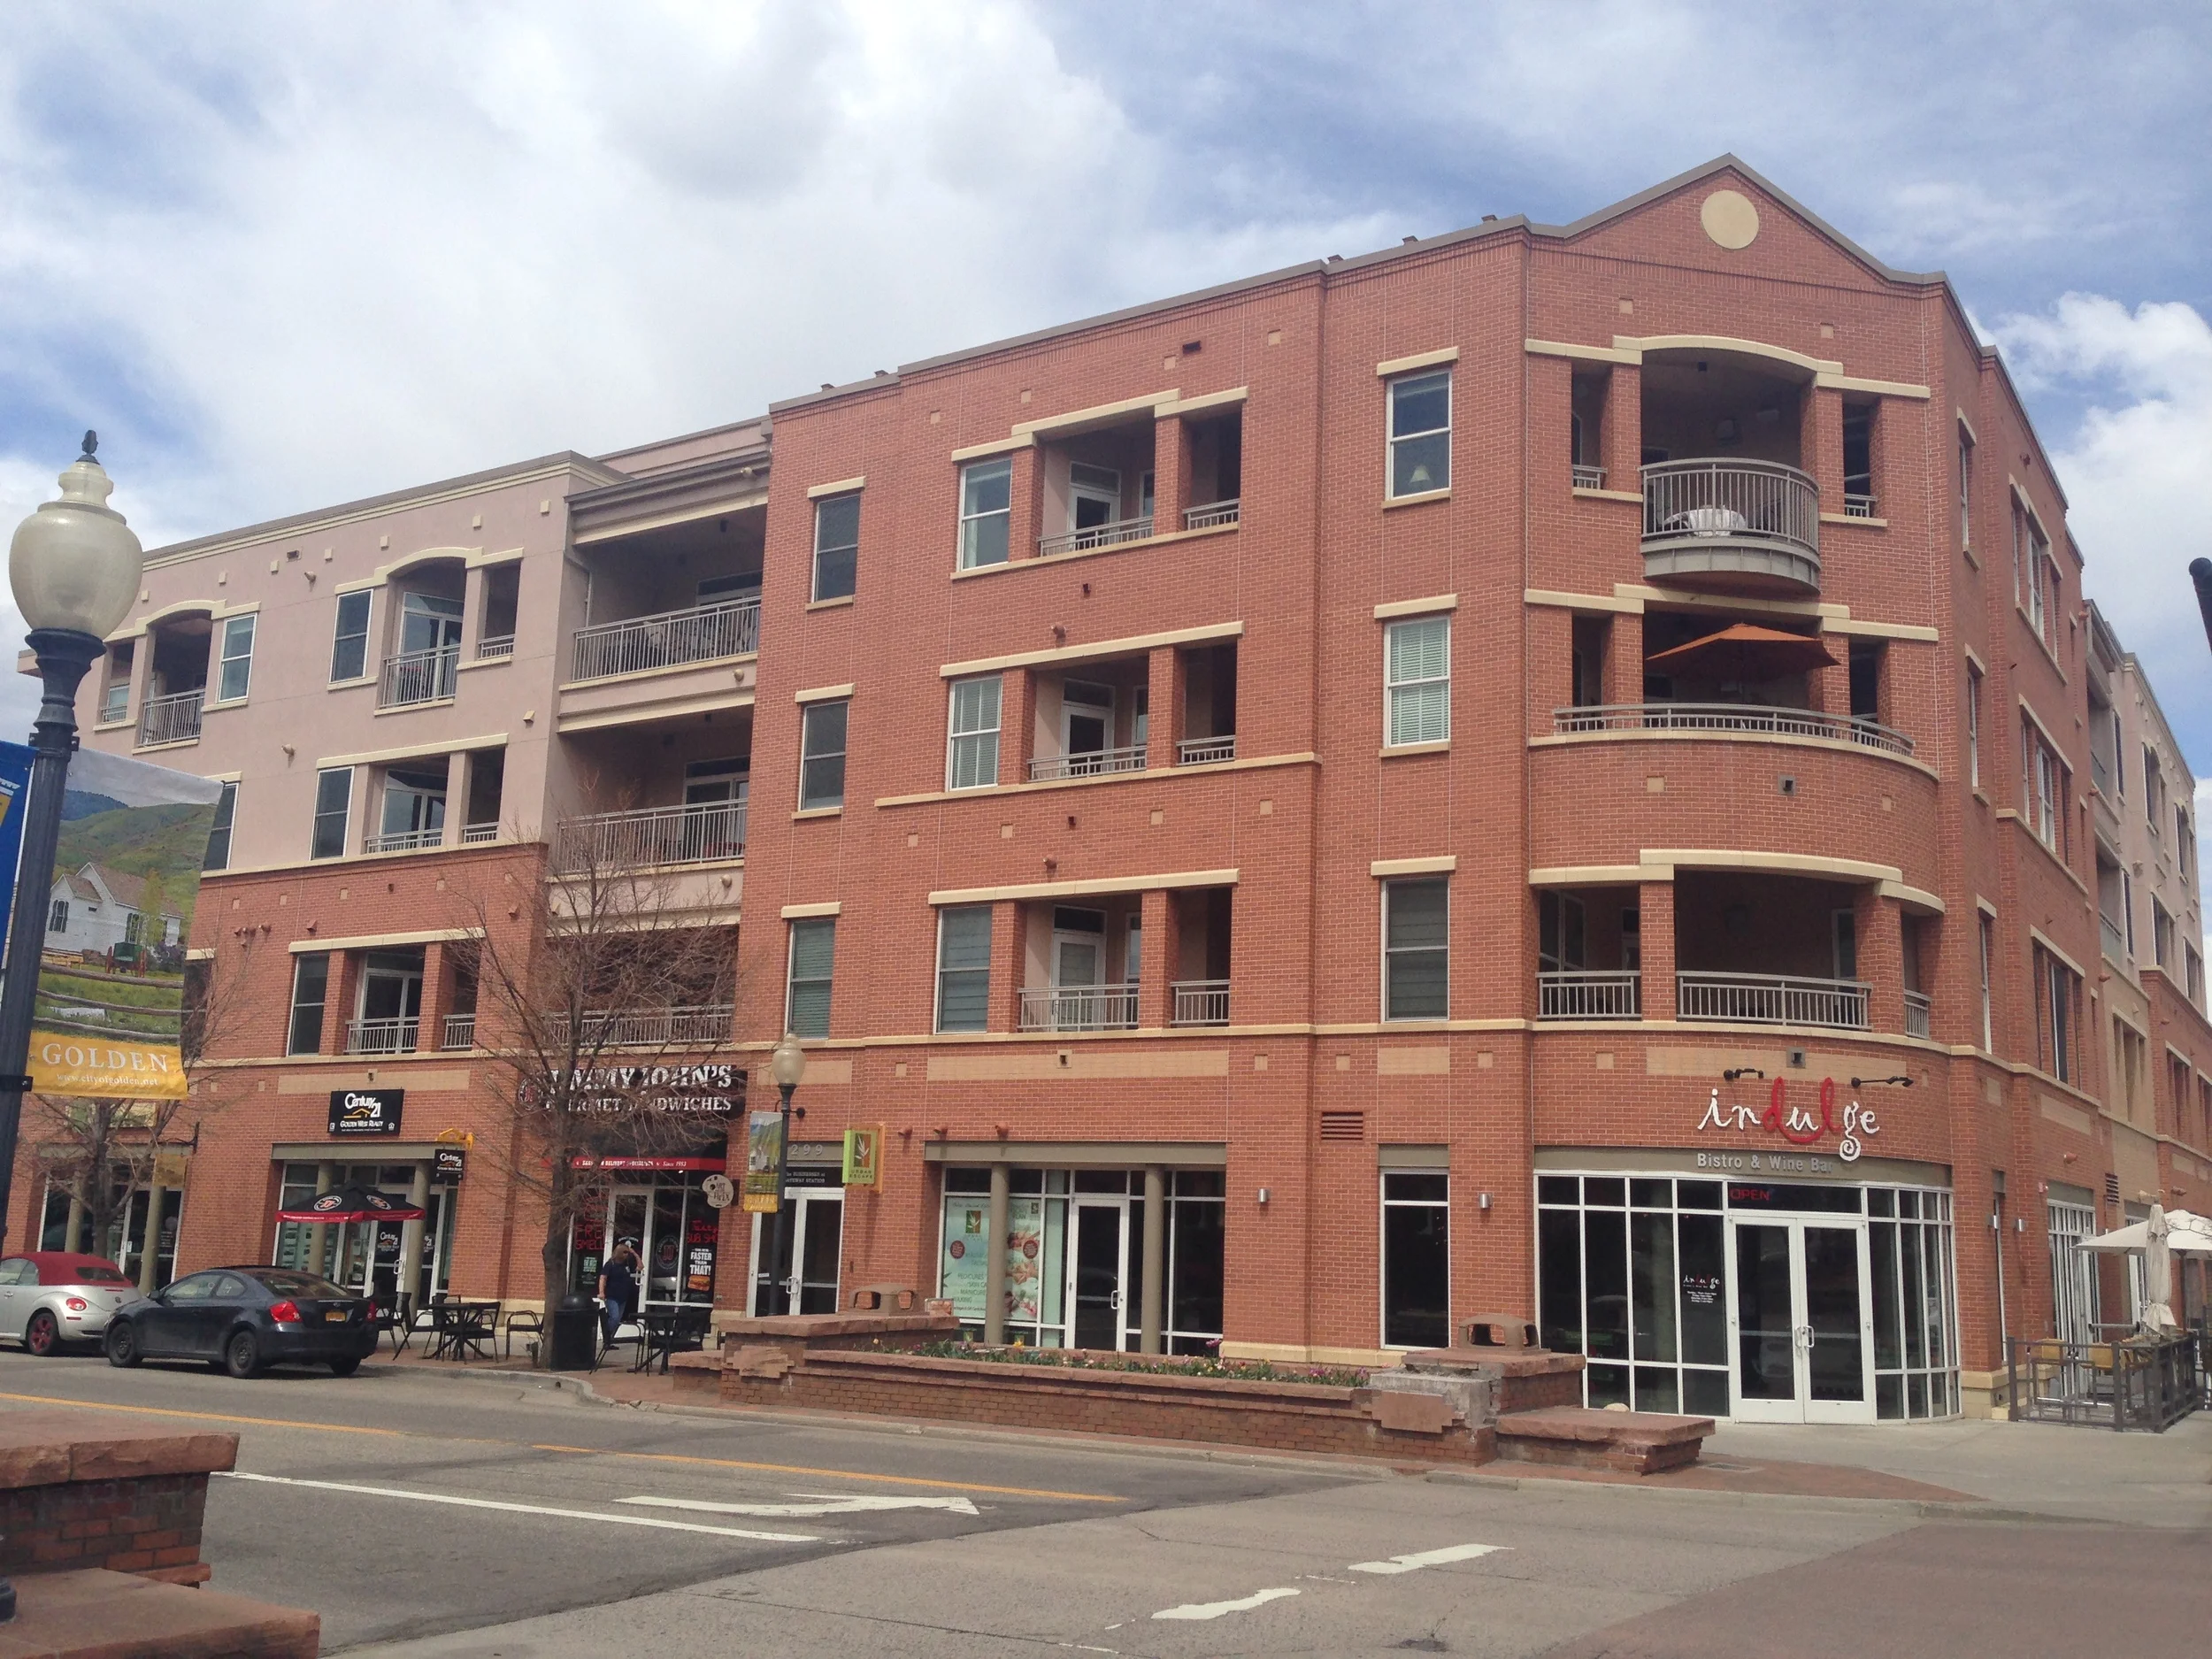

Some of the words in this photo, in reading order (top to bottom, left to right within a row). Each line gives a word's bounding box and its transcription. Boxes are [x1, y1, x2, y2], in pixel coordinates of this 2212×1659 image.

[42, 1043, 168, 1072] GOLDEN
[57, 1073, 159, 1086] www.cityofgolden.net
[344, 1093, 377, 1110] Century
[370, 1102, 381, 1118] 21
[1697, 1076, 1880, 1162] indulge
[790, 1144, 824, 1156] 299
[1697, 1153, 1743, 1168] Bistro
[1751, 1155, 1761, 1169] &
[1770, 1156, 1803, 1171] Wine
[1811, 1159, 1834, 1173] Bar
[1730, 1188, 1770, 1200] OPEN
[690, 1252, 712, 1261] FASTER
[689, 1264, 711, 1275] THAT!
